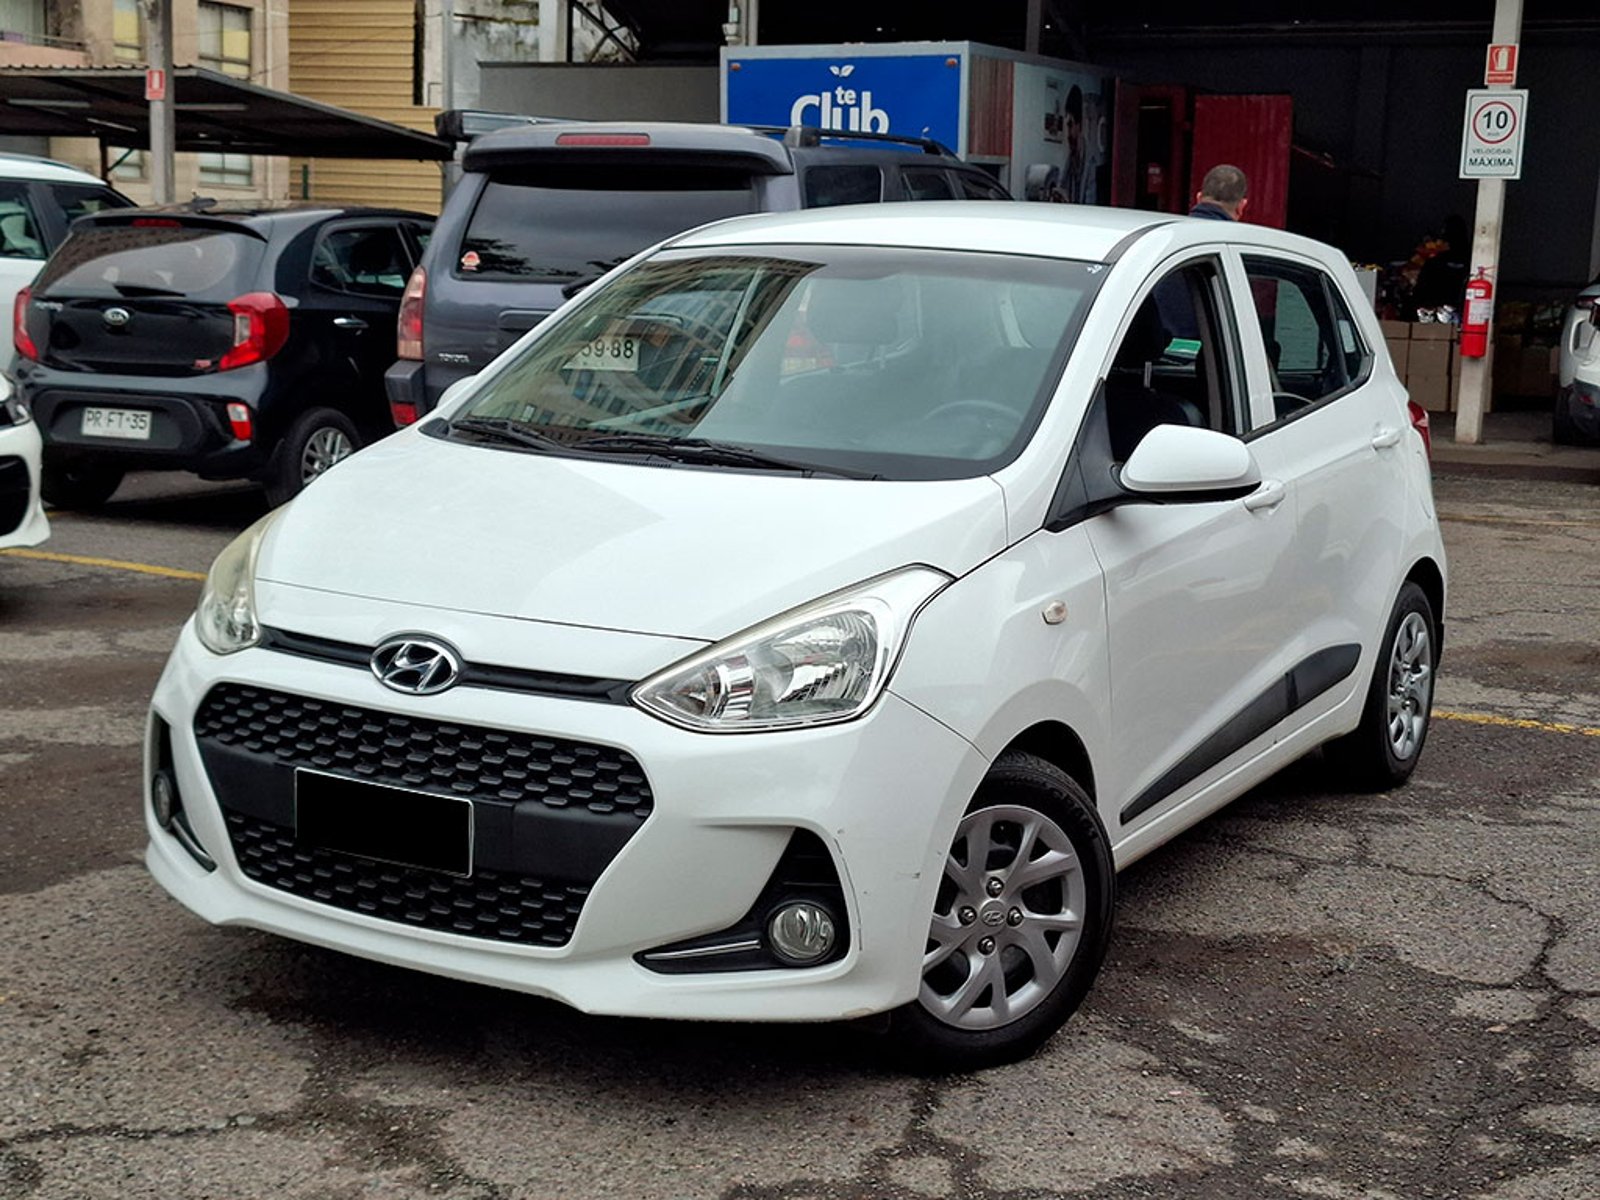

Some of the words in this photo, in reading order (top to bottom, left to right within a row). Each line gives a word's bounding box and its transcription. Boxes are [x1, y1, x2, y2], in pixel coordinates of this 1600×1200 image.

[835, 86, 857, 105] te
[790, 91, 890, 137] Club
[1482, 110, 1509, 129] 10
